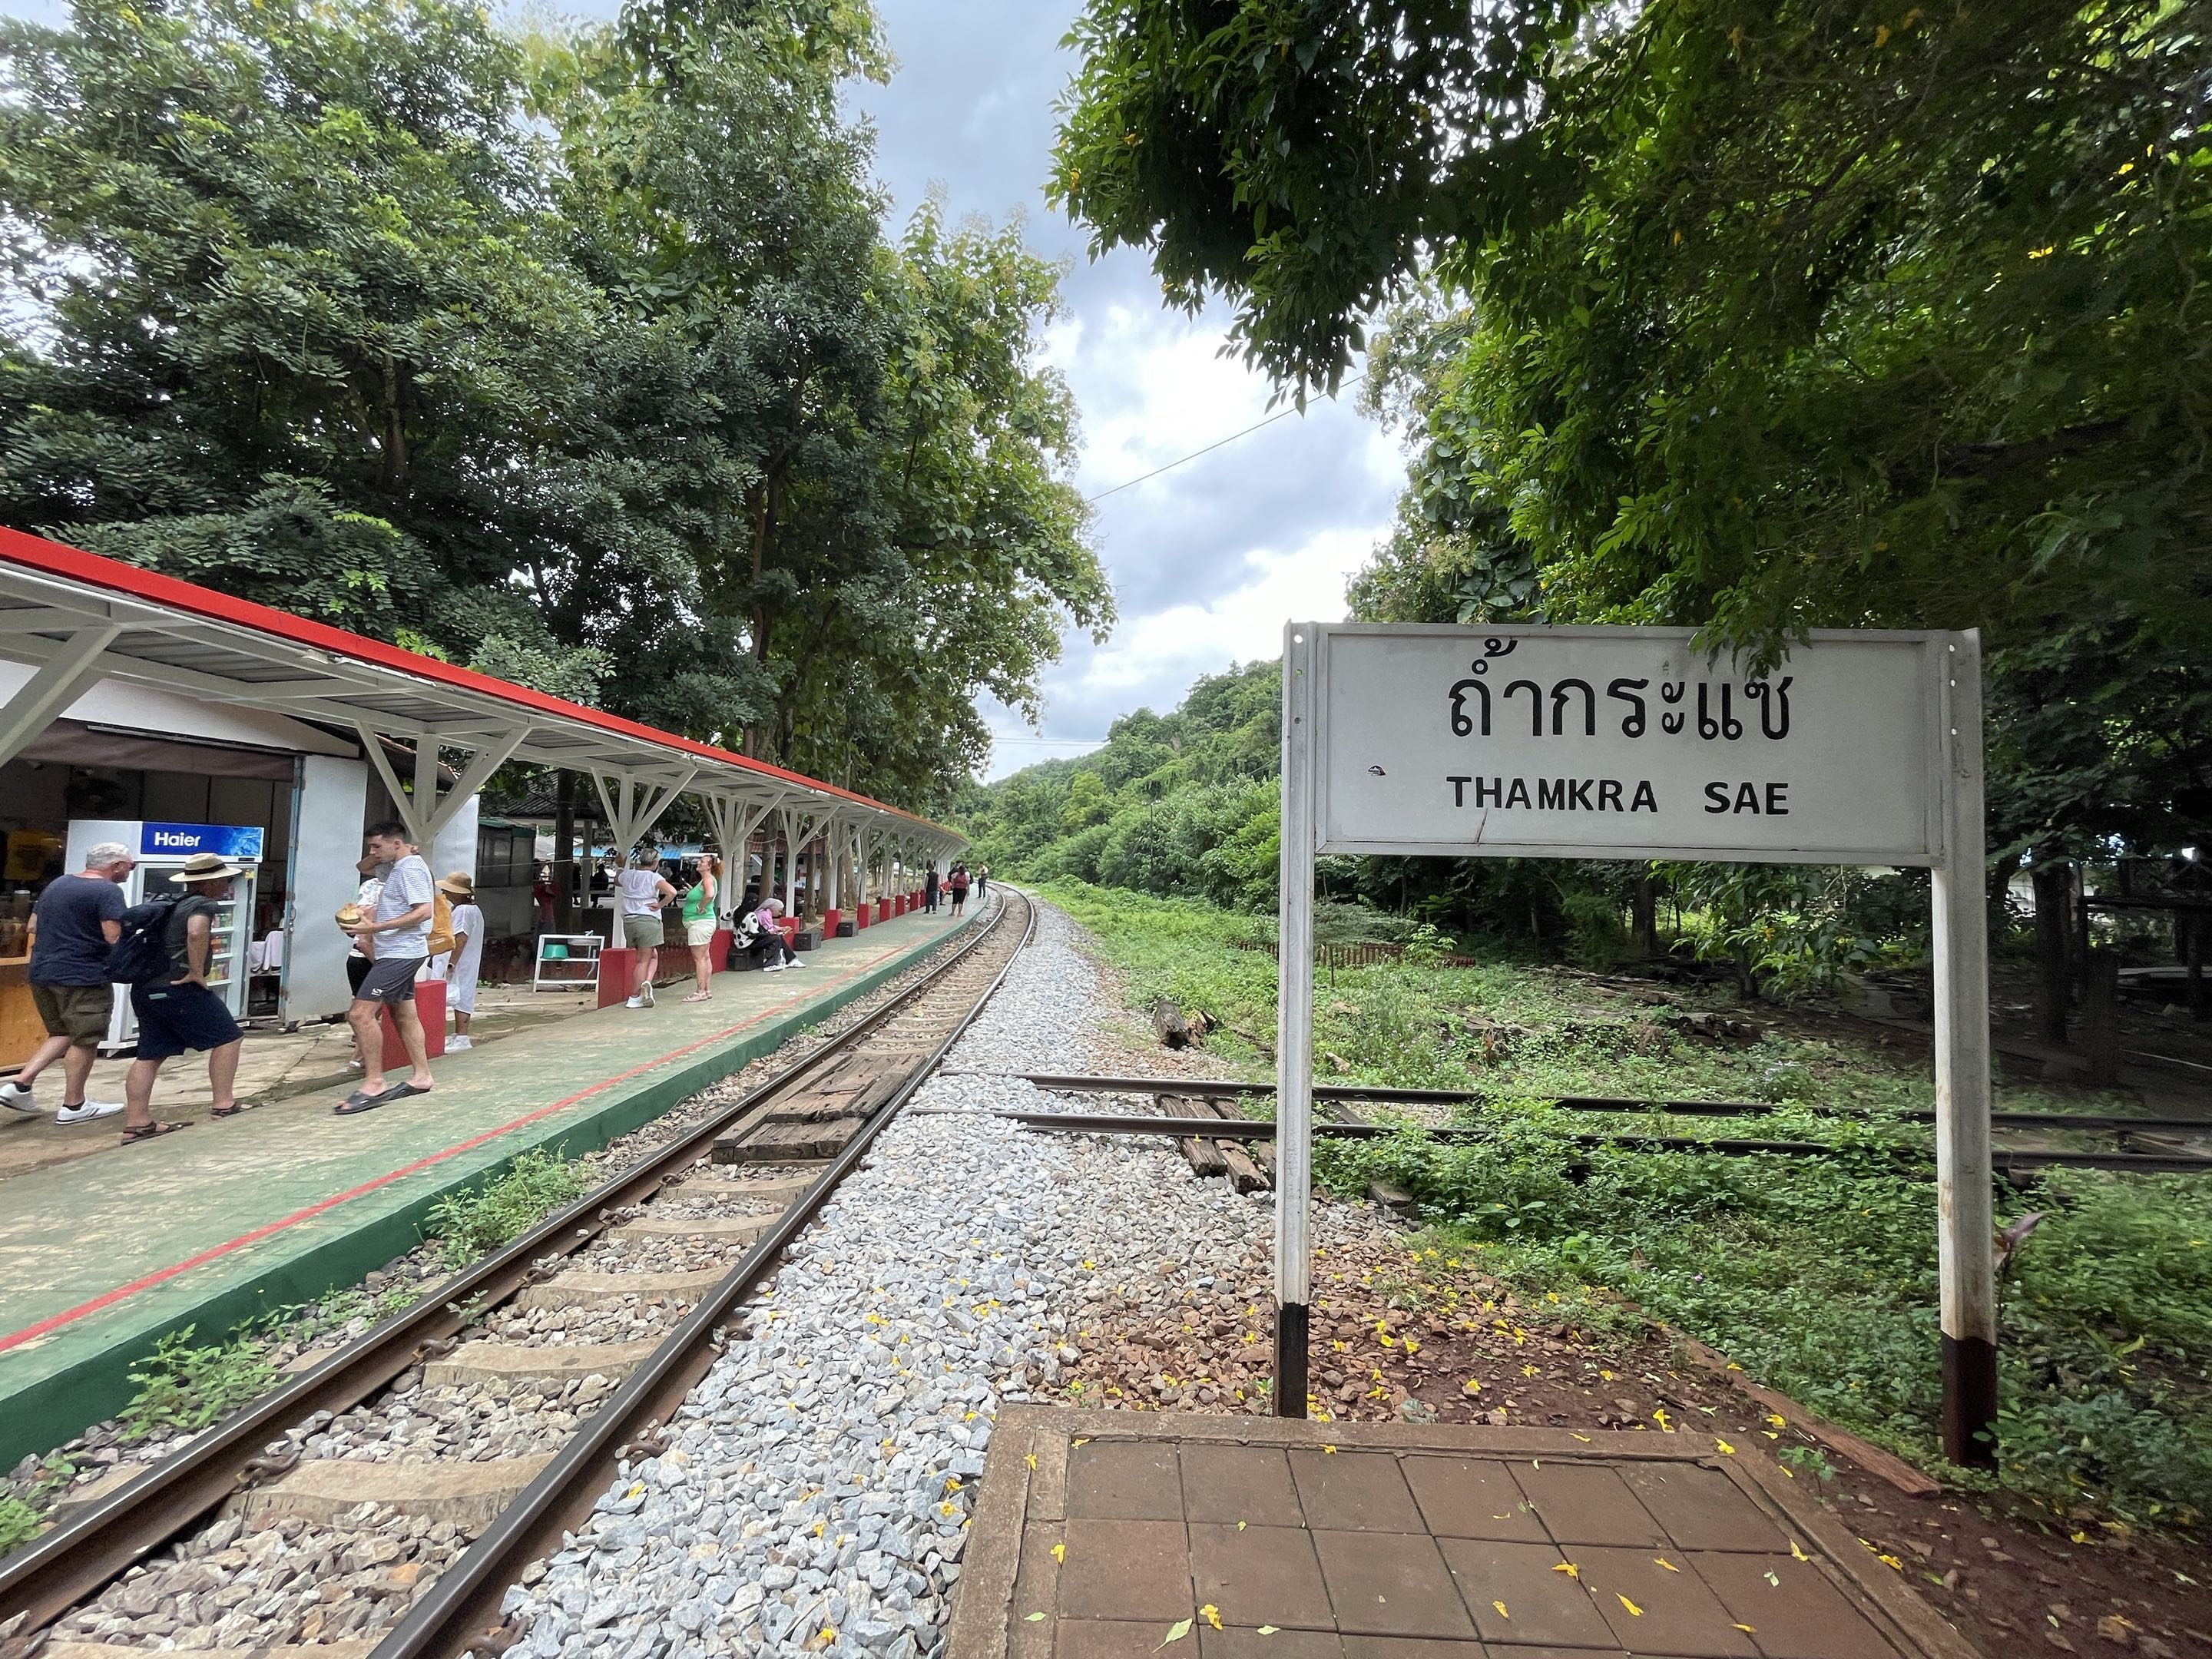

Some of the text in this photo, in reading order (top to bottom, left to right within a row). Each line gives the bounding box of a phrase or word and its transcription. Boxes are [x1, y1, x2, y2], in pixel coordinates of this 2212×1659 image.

[1448, 637, 1794, 740] ถ้ำกระแซ
[1445, 776, 1789, 815] THAMKRA SAE
[154, 831, 201, 847] Haier
